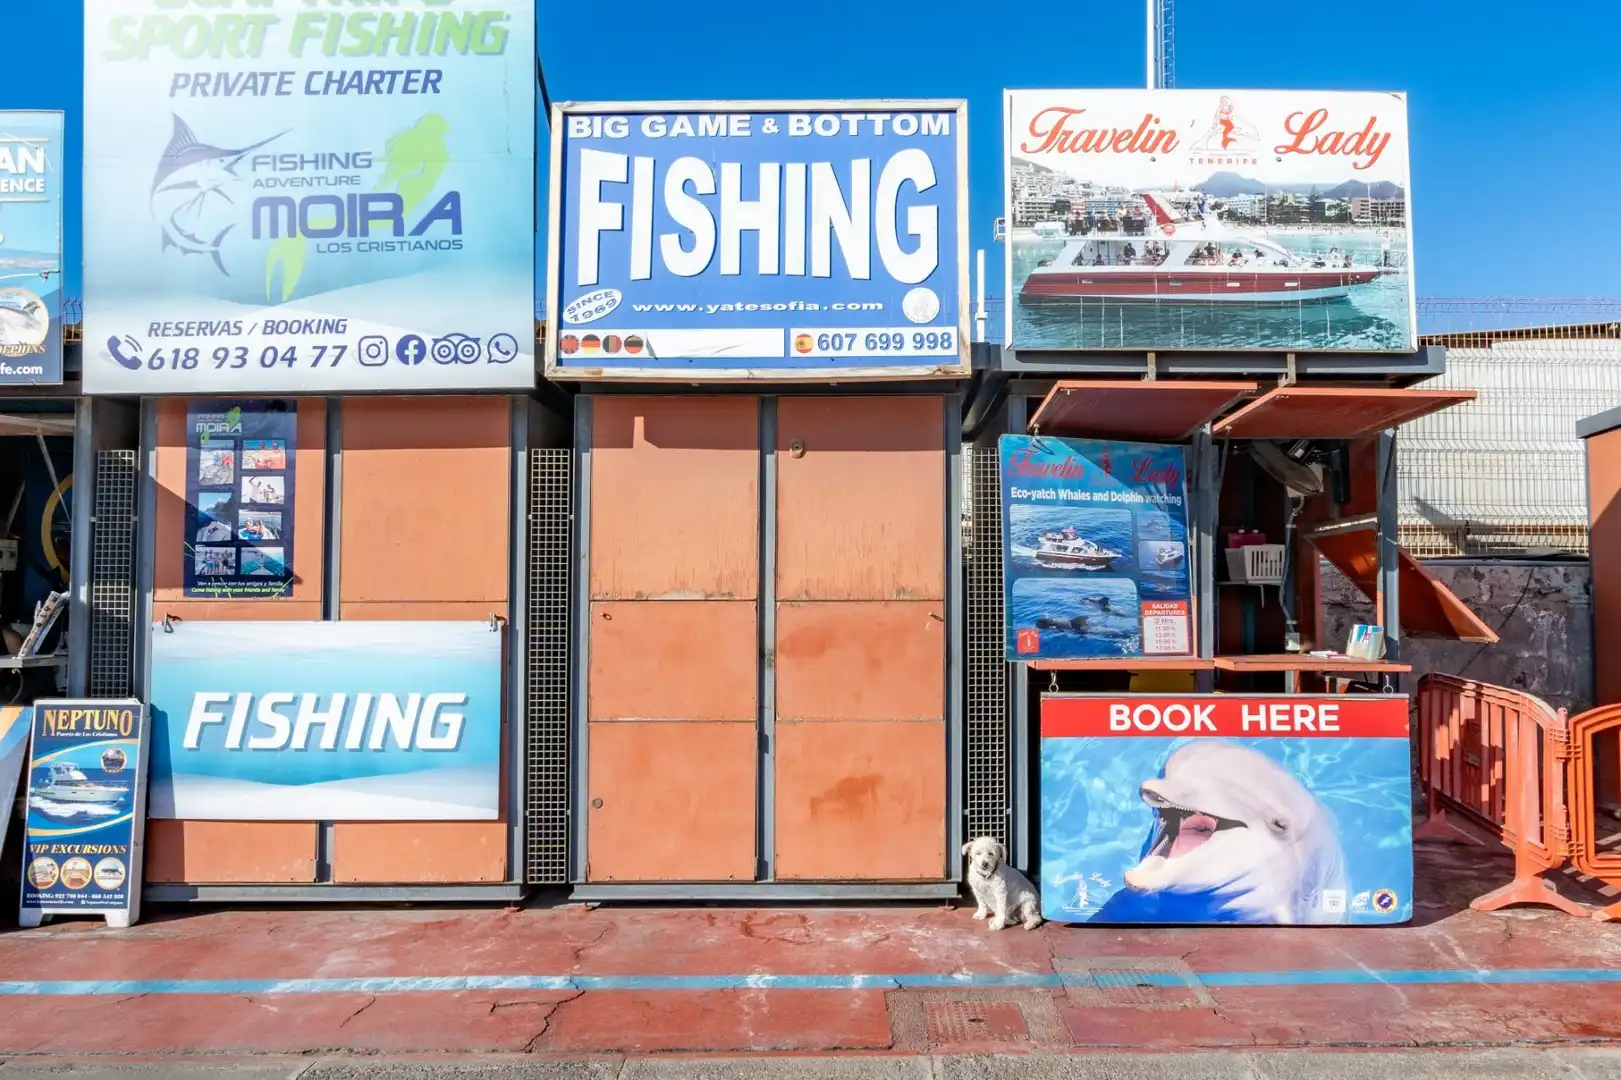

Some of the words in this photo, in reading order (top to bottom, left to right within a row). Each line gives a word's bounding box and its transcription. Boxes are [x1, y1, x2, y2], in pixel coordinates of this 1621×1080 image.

[103, 13, 279, 60] SPORT
[288, 11, 509, 57] FISHING
[169, 71, 296, 98] PRIVATE
[304, 69, 443, 95] CHARTER
[568, 115, 630, 138] BIG
[641, 115, 751, 138] GAME
[761, 117, 780, 135] &
[788, 114, 951, 137] BOTTOM
[1020, 106, 1180, 154] Travelin
[1274, 108, 1392, 170] Lady
[252, 151, 373, 172] FISHING
[252, 175, 361, 188] ADVENTURE
[252, 191, 463, 239] MOIRA
[578, 148, 940, 287] FISHING
[317, 242, 352, 253] LOS
[357, 239, 463, 252] CRISTIANOS
[567, 290, 615, 315] SINCE
[570, 298, 618, 322] 1969
[632, 301, 884, 314] www.yatesofia.com
[148, 320, 243, 338] RESERVAS
[247, 322, 258, 336] /
[262, 318, 348, 335] BOOKING
[817, 332, 857, 351] 607
[865, 332, 905, 351] 699
[912, 331, 952, 350] 998
[147, 347, 200, 370] 618
[212, 346, 249, 369] 93
[260, 345, 298, 368] 04
[310, 344, 348, 368] 77
[196, 422, 242, 433] MOIRA
[1011, 487, 1056, 501] Eco-yatch
[1059, 489, 1090, 501] Whales
[1092, 491, 1109, 502] and
[1111, 491, 1143, 505] Dolphin
[1145, 495, 1182, 506] watching
[42, 709, 133, 737] NEPTUNO
[183, 691, 468, 750] FISHING
[1109, 704, 1217, 731] BOOK
[1241, 704, 1341, 731] HERE
[30, 844, 49, 854] VIP
[51, 844, 128, 854] EXCURSIONS
